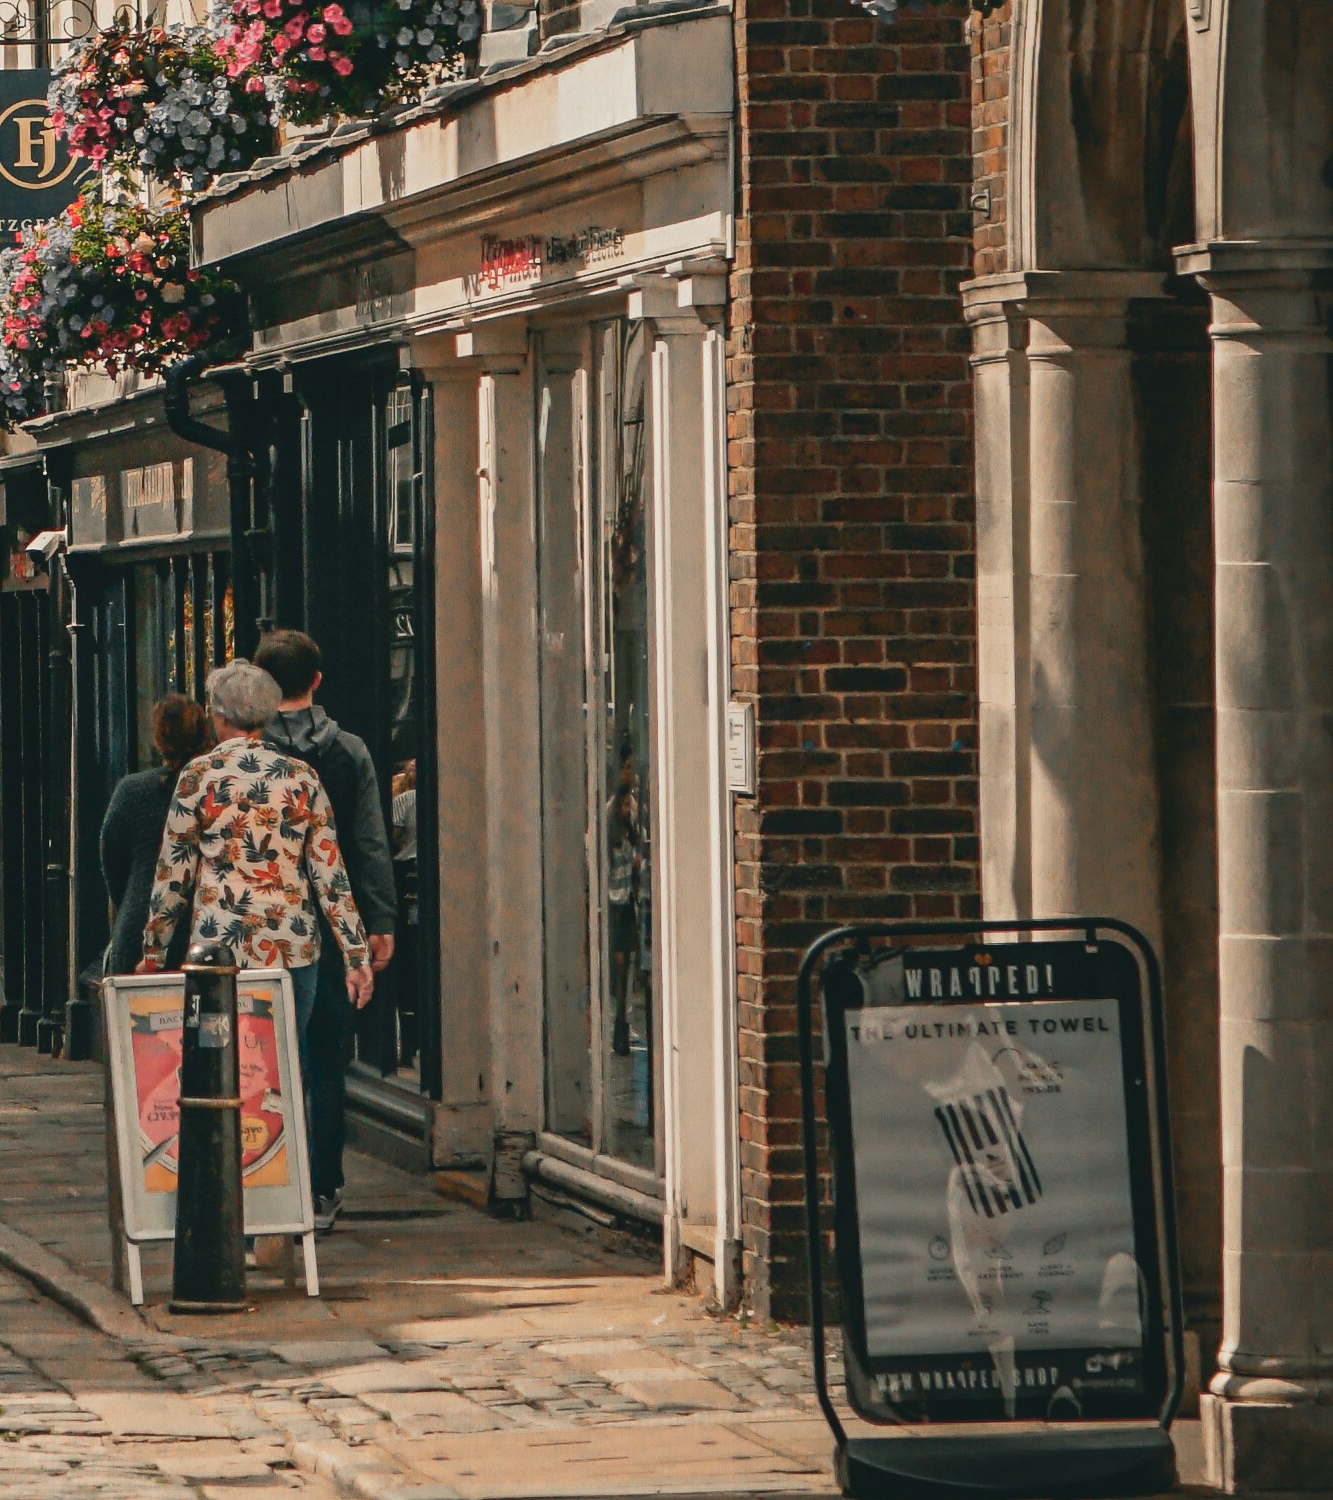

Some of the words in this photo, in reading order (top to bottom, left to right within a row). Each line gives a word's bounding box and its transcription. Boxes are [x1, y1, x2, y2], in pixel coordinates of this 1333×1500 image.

[905, 964, 1053, 998] WRAPPED!
[850, 1025, 893, 1041] THE
[905, 1020, 1017, 1039] ULTIMATE
[1028, 1017, 1110, 1034] TOWEL
